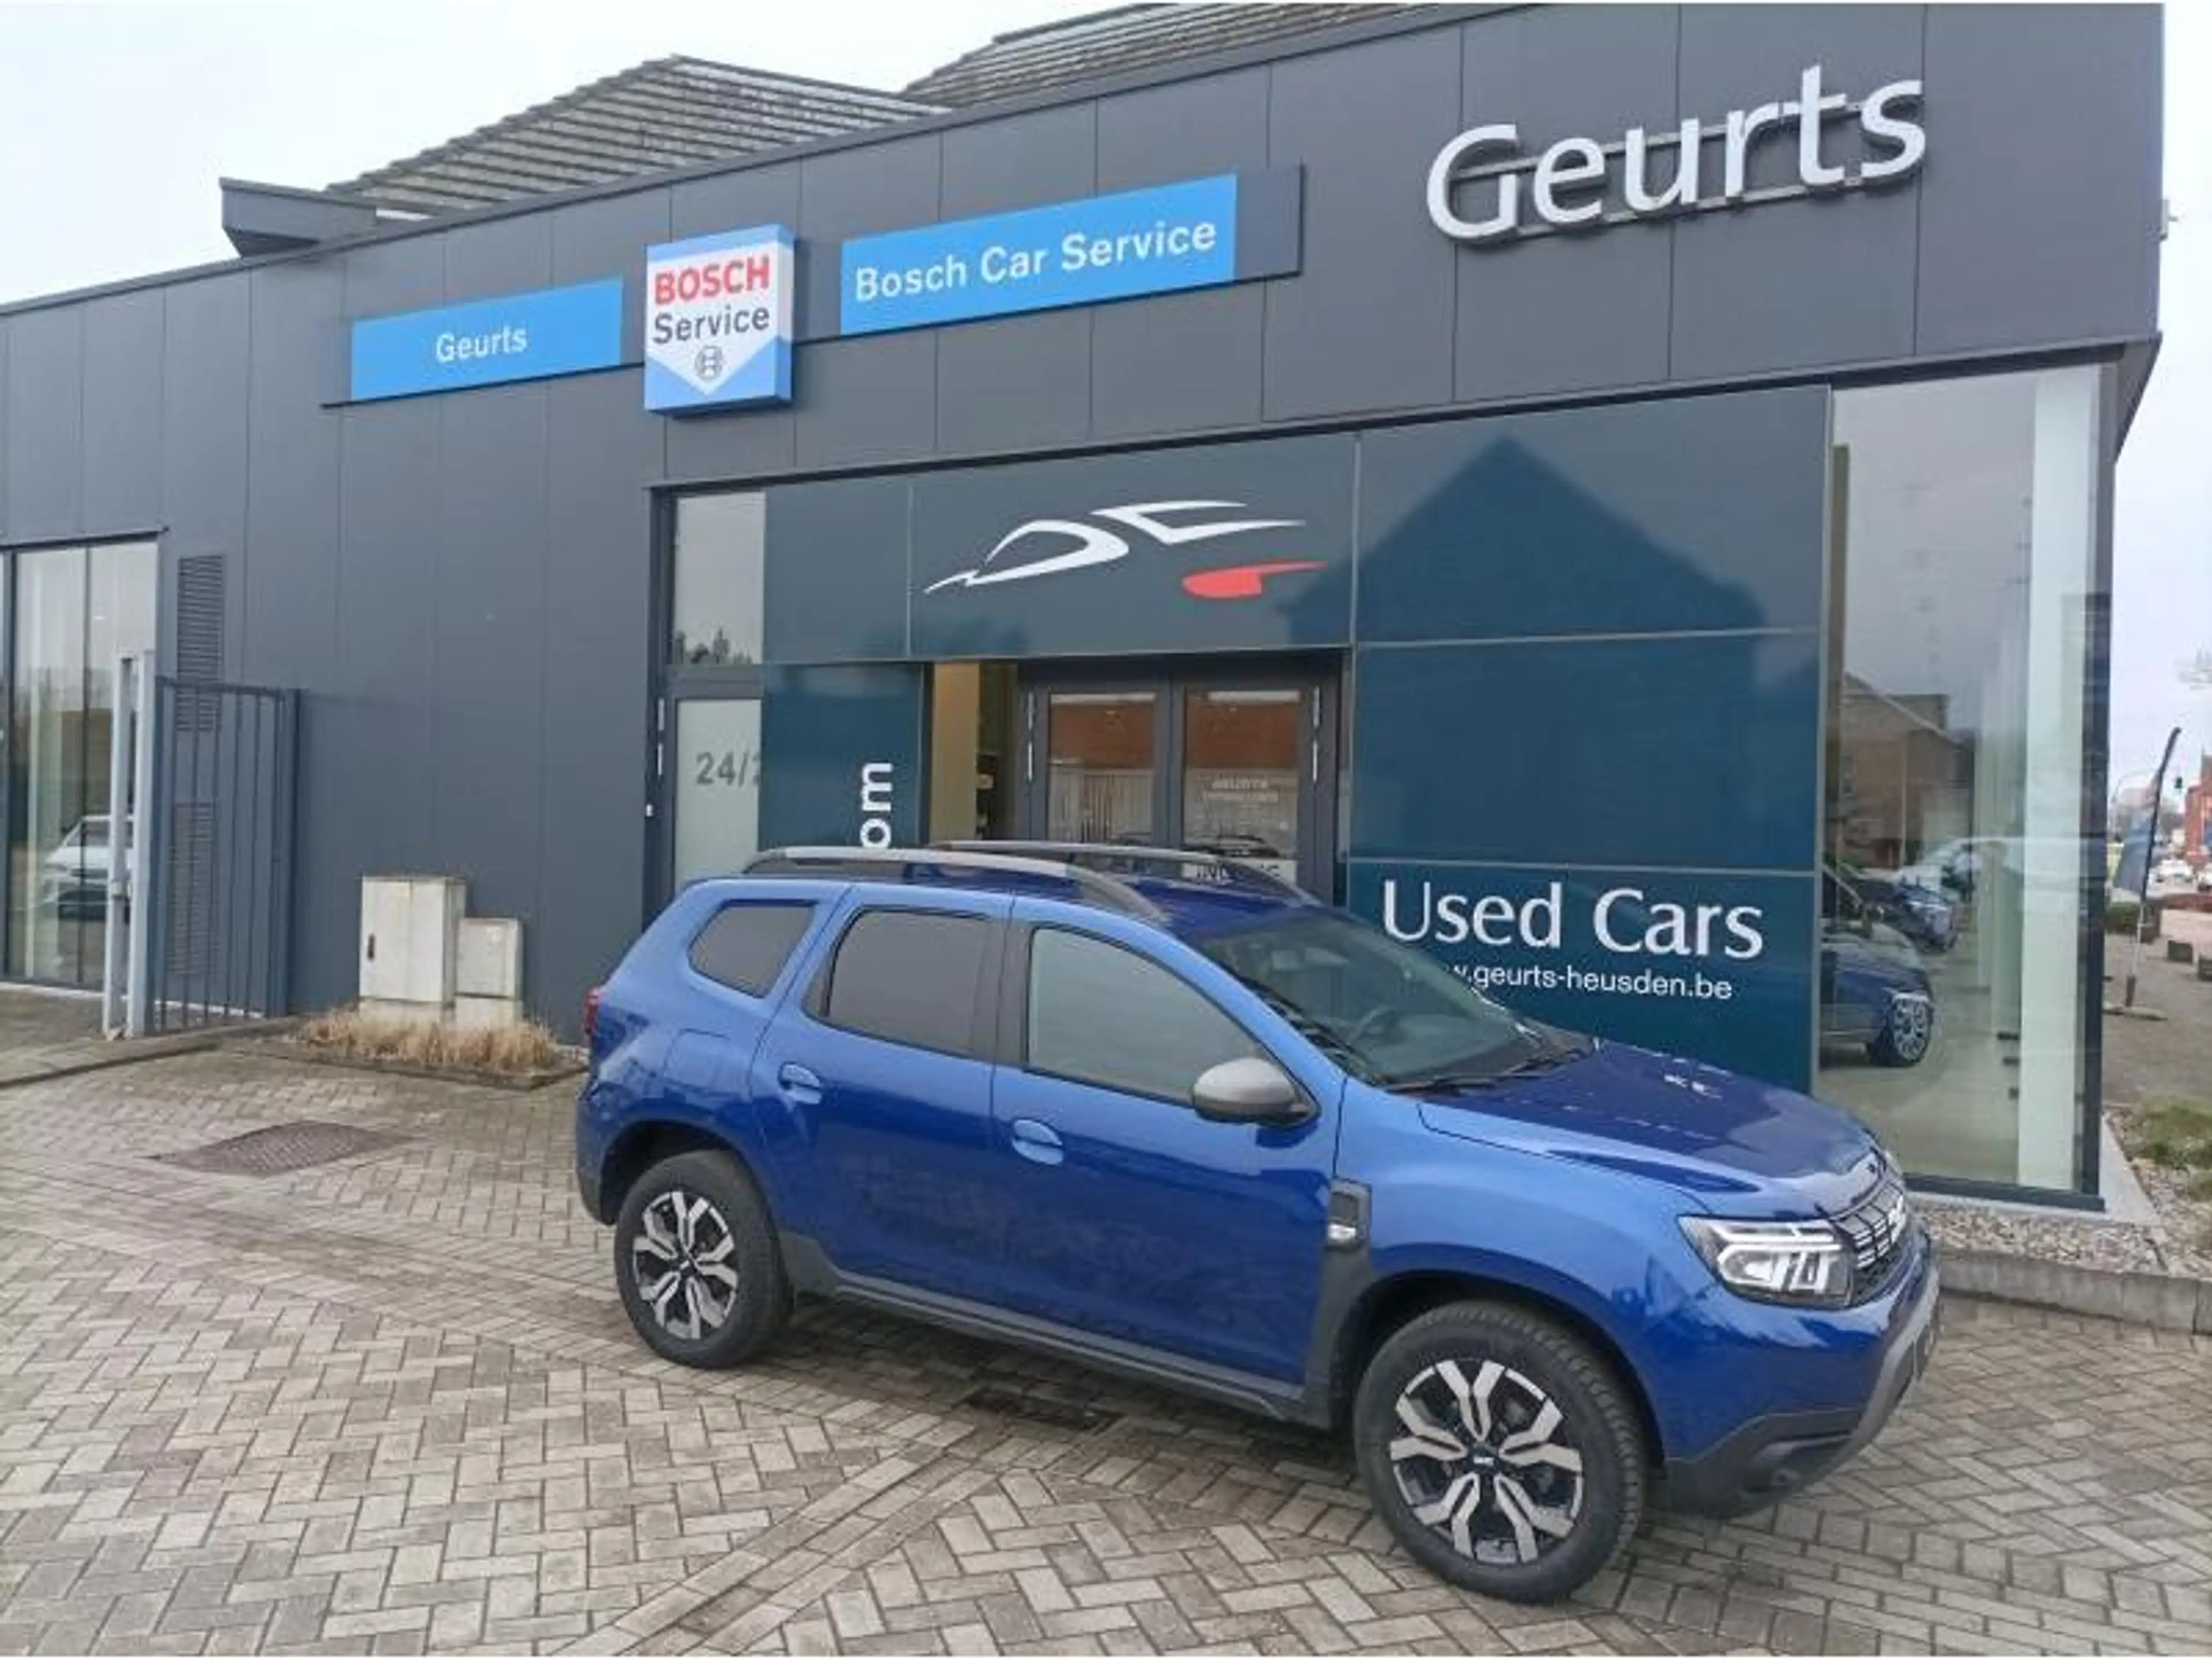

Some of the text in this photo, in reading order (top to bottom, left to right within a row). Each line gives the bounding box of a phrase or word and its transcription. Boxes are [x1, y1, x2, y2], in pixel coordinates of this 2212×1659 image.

[1426, 65, 1926, 240] Geurts
[654, 255, 771, 306] BOSCH
[855, 221, 1217, 302] Bosch Car Service
[435, 325, 528, 363] Geurts
[653, 303, 770, 344] Service
[860, 762, 893, 848] om
[1383, 880, 1764, 960] Used Cars
[1444, 963, 1733, 1001] w.geurts-heusden.be
